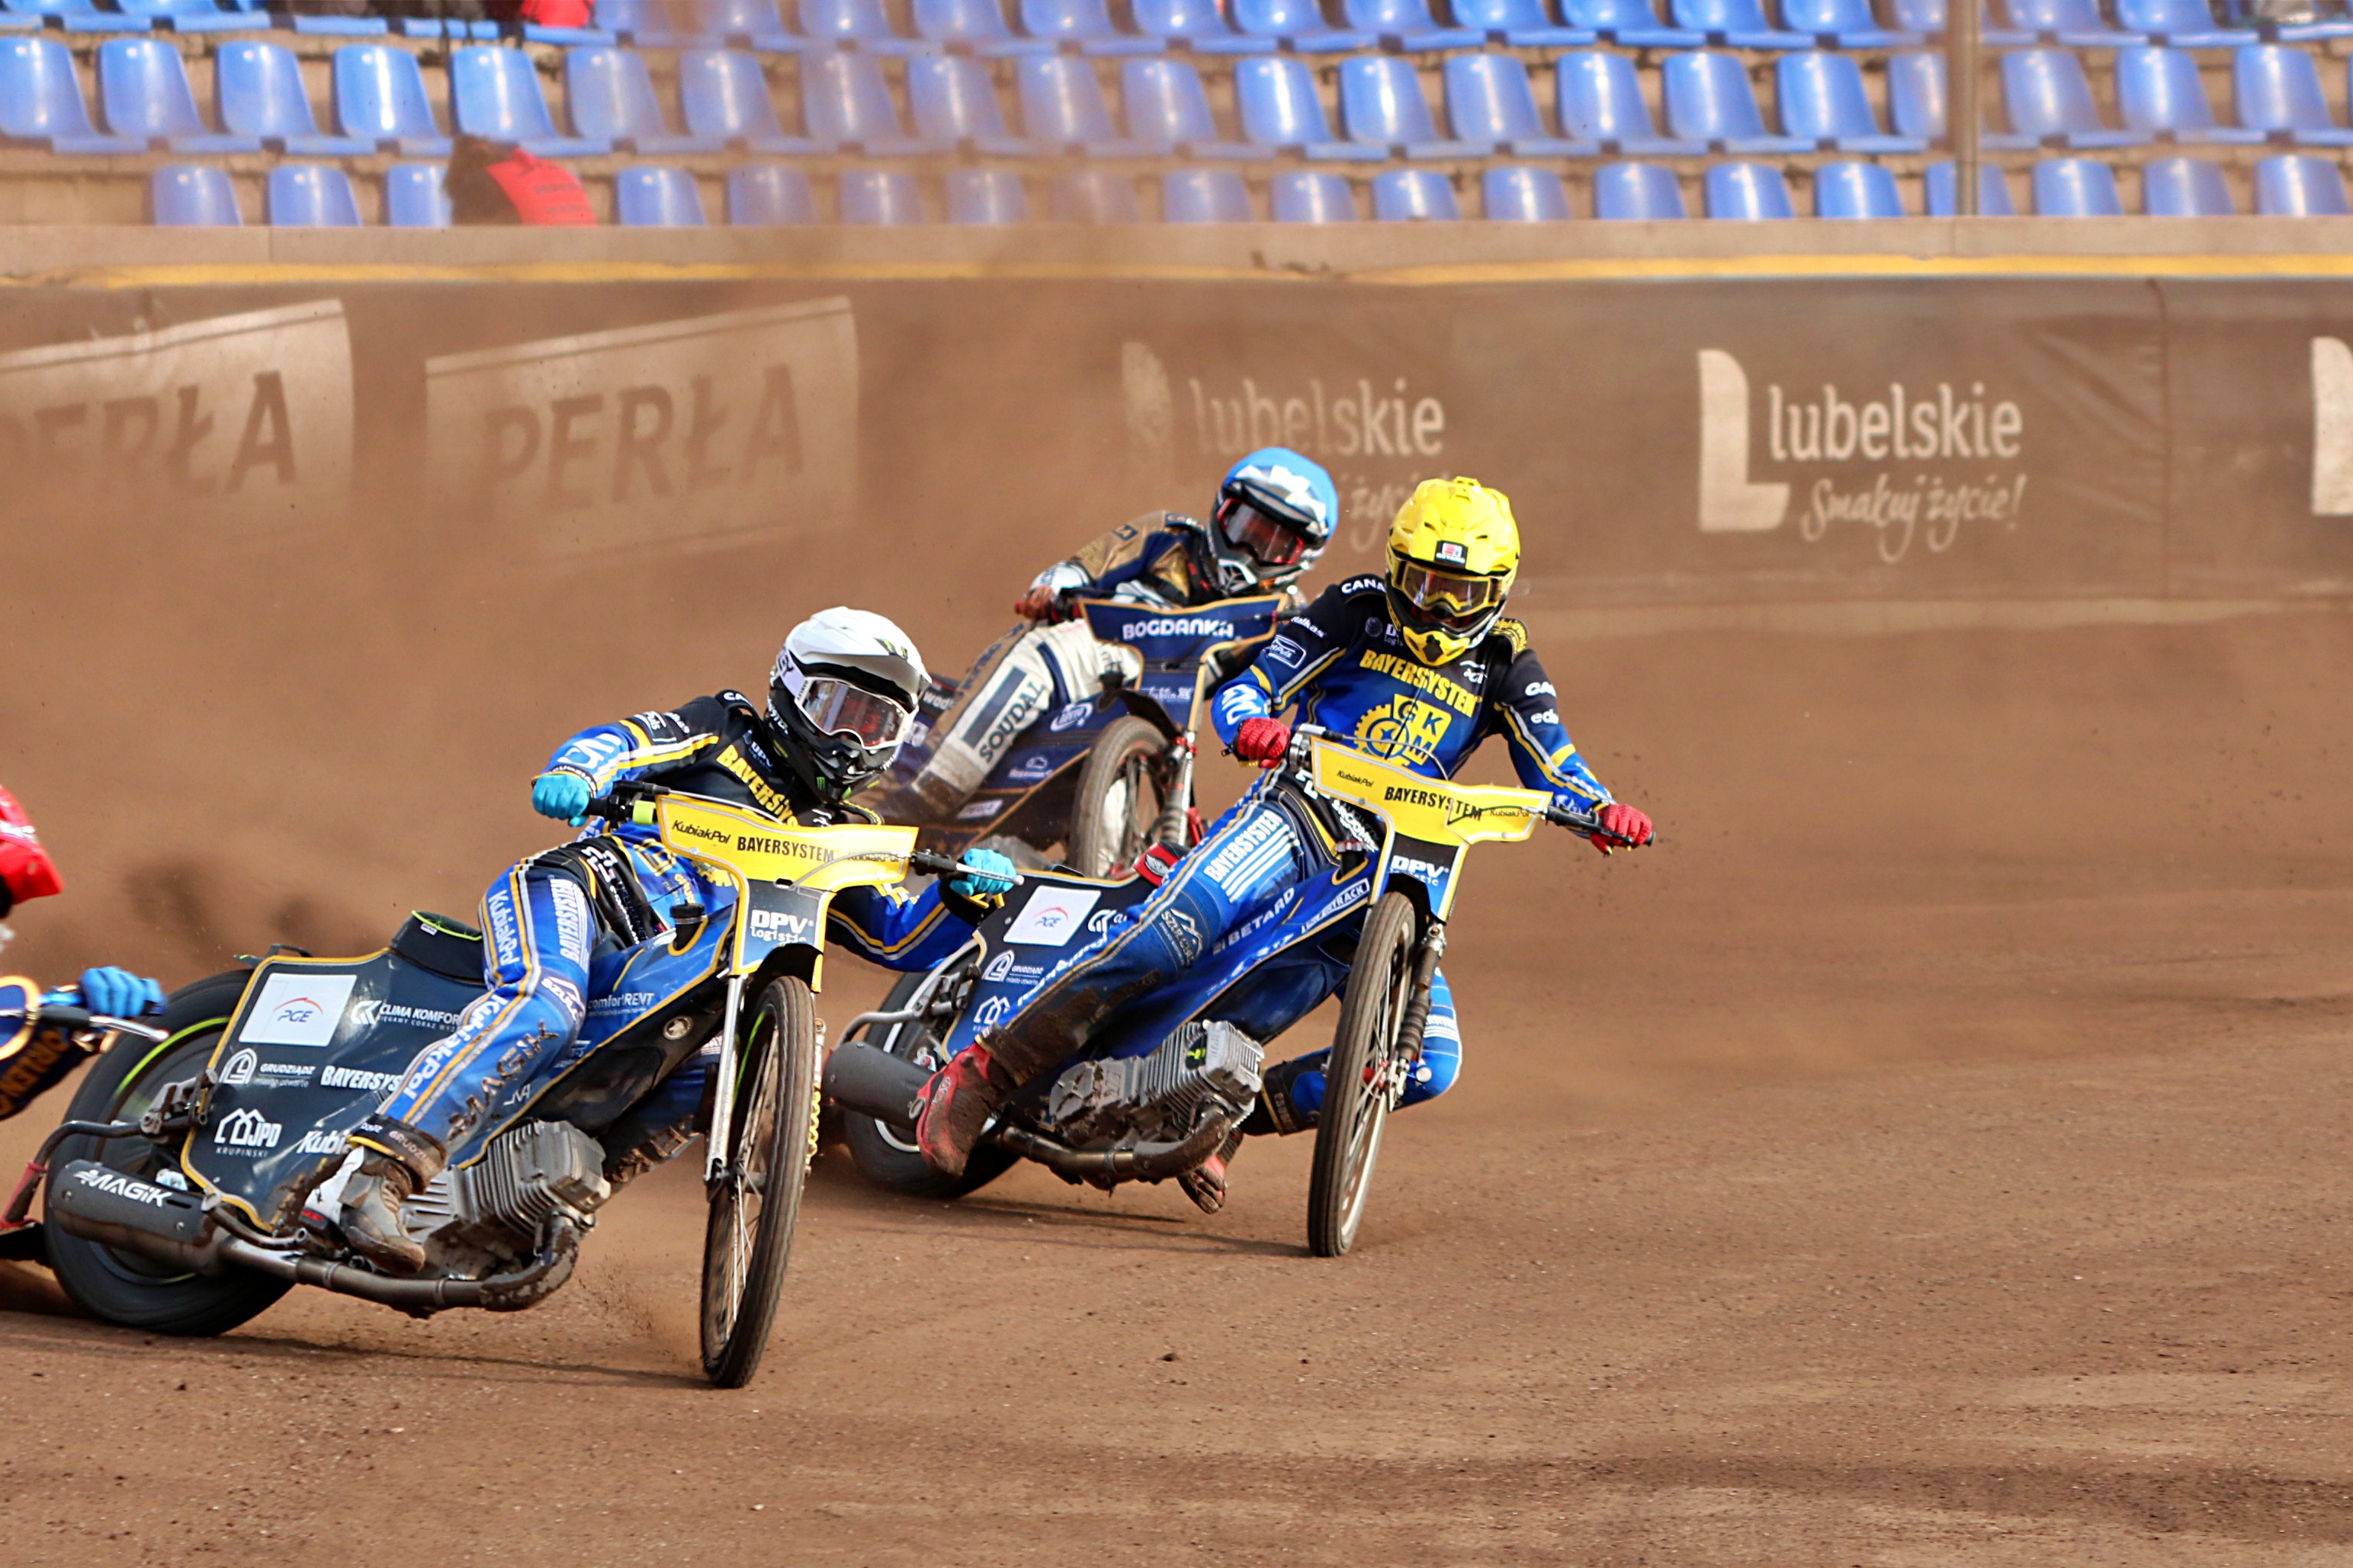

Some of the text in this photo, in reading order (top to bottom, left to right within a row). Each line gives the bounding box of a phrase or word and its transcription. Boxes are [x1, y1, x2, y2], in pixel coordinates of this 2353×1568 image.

[474, 362, 807, 514] PERŁA
[1801, 473, 2027, 563] Smakuj życie!
[1359, 649, 1477, 718] BAYERSYSTEM
[979, 680, 1047, 763] SOUDAL
[1337, 770, 1374, 788] KubiakPol
[1384, 786, 1481, 822] BAYERSYSTEM
[1489, 808, 1530, 819] KubiakPol
[672, 820, 731, 844] KubiakPol
[1203, 809, 1284, 883] BAYERSYSTEM
[737, 836, 834, 863] BAYERSYSTEM
[1390, 855, 1444, 879] DPV
[488, 889, 519, 966] KubiakPol
[550, 878, 583, 964] BAYERSYSTEM
[750, 909, 808, 935] DPV
[1228, 887, 1295, 948] BETARD
[278, 1009, 313, 1023] PGE
[379, 1003, 412, 1018] CLIMA
[403, 994, 509, 1100] KubiakPol
[260, 1063, 316, 1076] GRUDZIĄDZ
[88, 1174, 173, 1207] MAGIK
